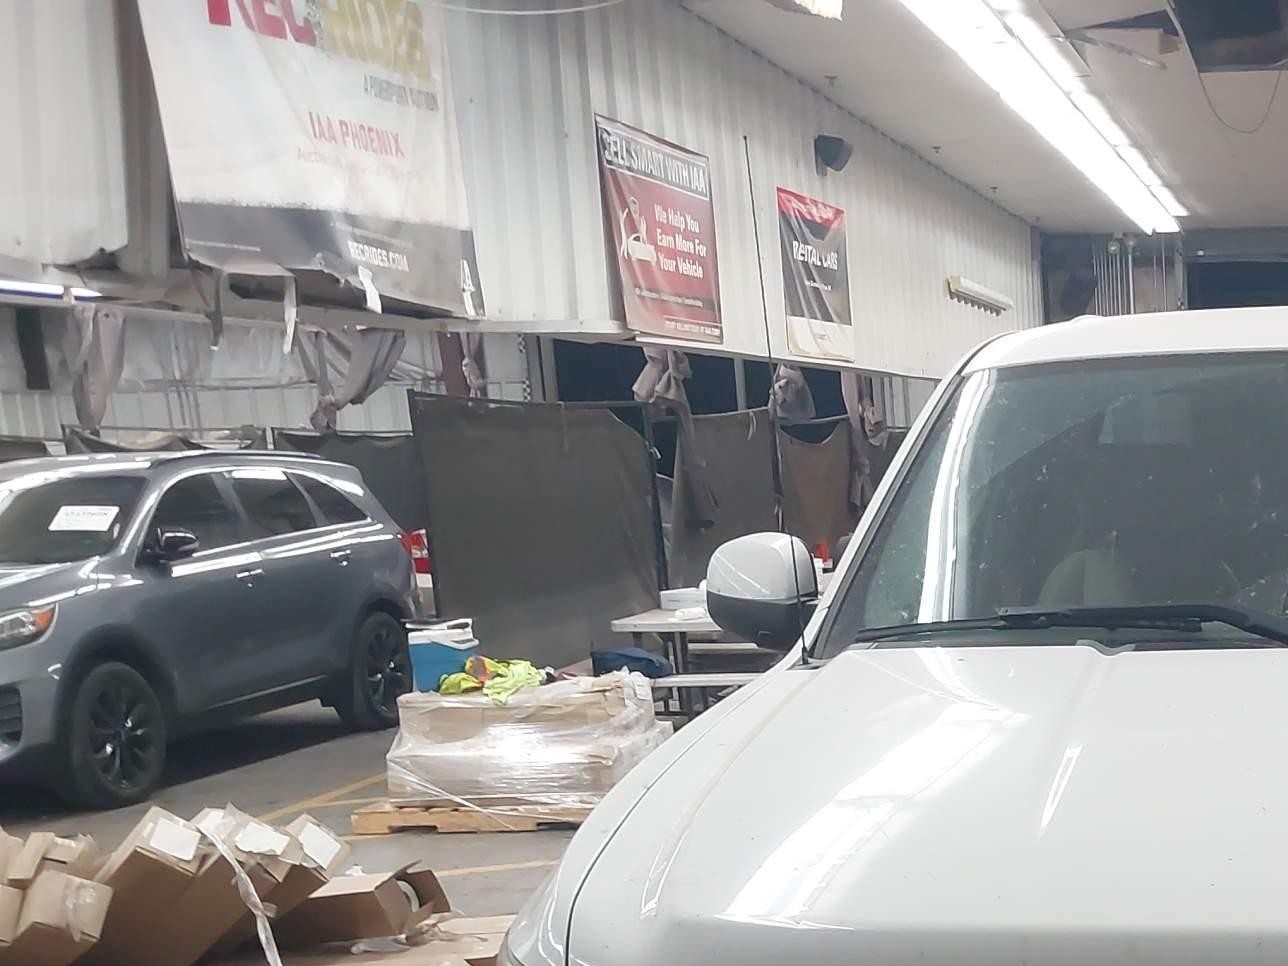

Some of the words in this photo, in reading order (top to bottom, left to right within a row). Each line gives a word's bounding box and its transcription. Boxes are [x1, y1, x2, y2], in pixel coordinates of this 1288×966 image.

[308, 111, 337, 144] IAA
[338, 119, 406, 159] PHOENIX
[631, 146, 664, 179] SMART
[665, 156, 689, 188] WITH
[689, 165, 706, 194] IAA
[654, 203, 667, 224] We
[668, 208, 685, 233] Help
[685, 213, 700, 233] You
[347, 240, 410, 273] RECRIDES.COM
[656, 228, 674, 249] Earn
[675, 233, 694, 255] More
[695, 239, 707, 257] For
[658, 252, 676, 272] Your
[676, 257, 704, 279] Vehicle
